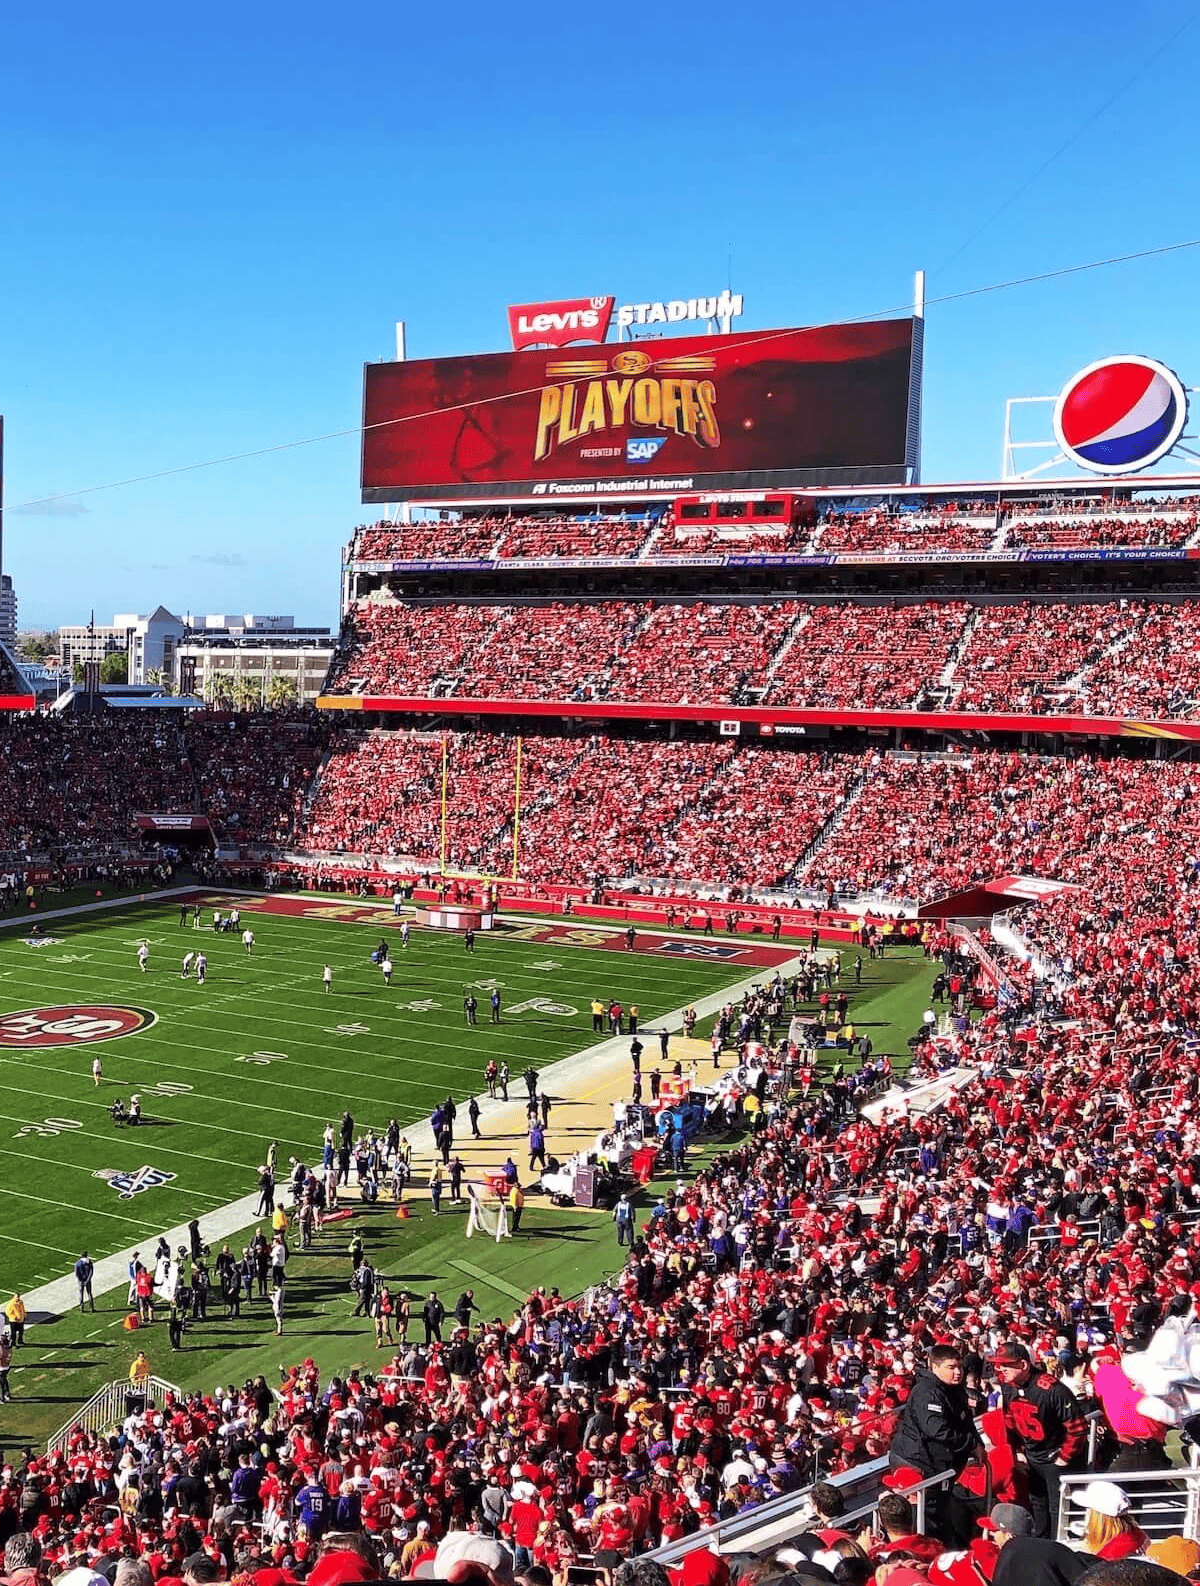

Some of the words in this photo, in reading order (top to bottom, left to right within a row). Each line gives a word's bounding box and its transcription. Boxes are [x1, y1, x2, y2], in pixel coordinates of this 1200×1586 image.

[618, 294, 744, 326] STADIUM
[534, 377, 721, 462] PLAYOFFS
[627, 442, 658, 459] SAP
[549, 481, 595, 494] Foxconn
[597, 479, 648, 491] Industrial
[650, 478, 693, 490] Internet
[774, 726, 806, 734] TOYOTA
[310, 1498, 323, 1512] 19
